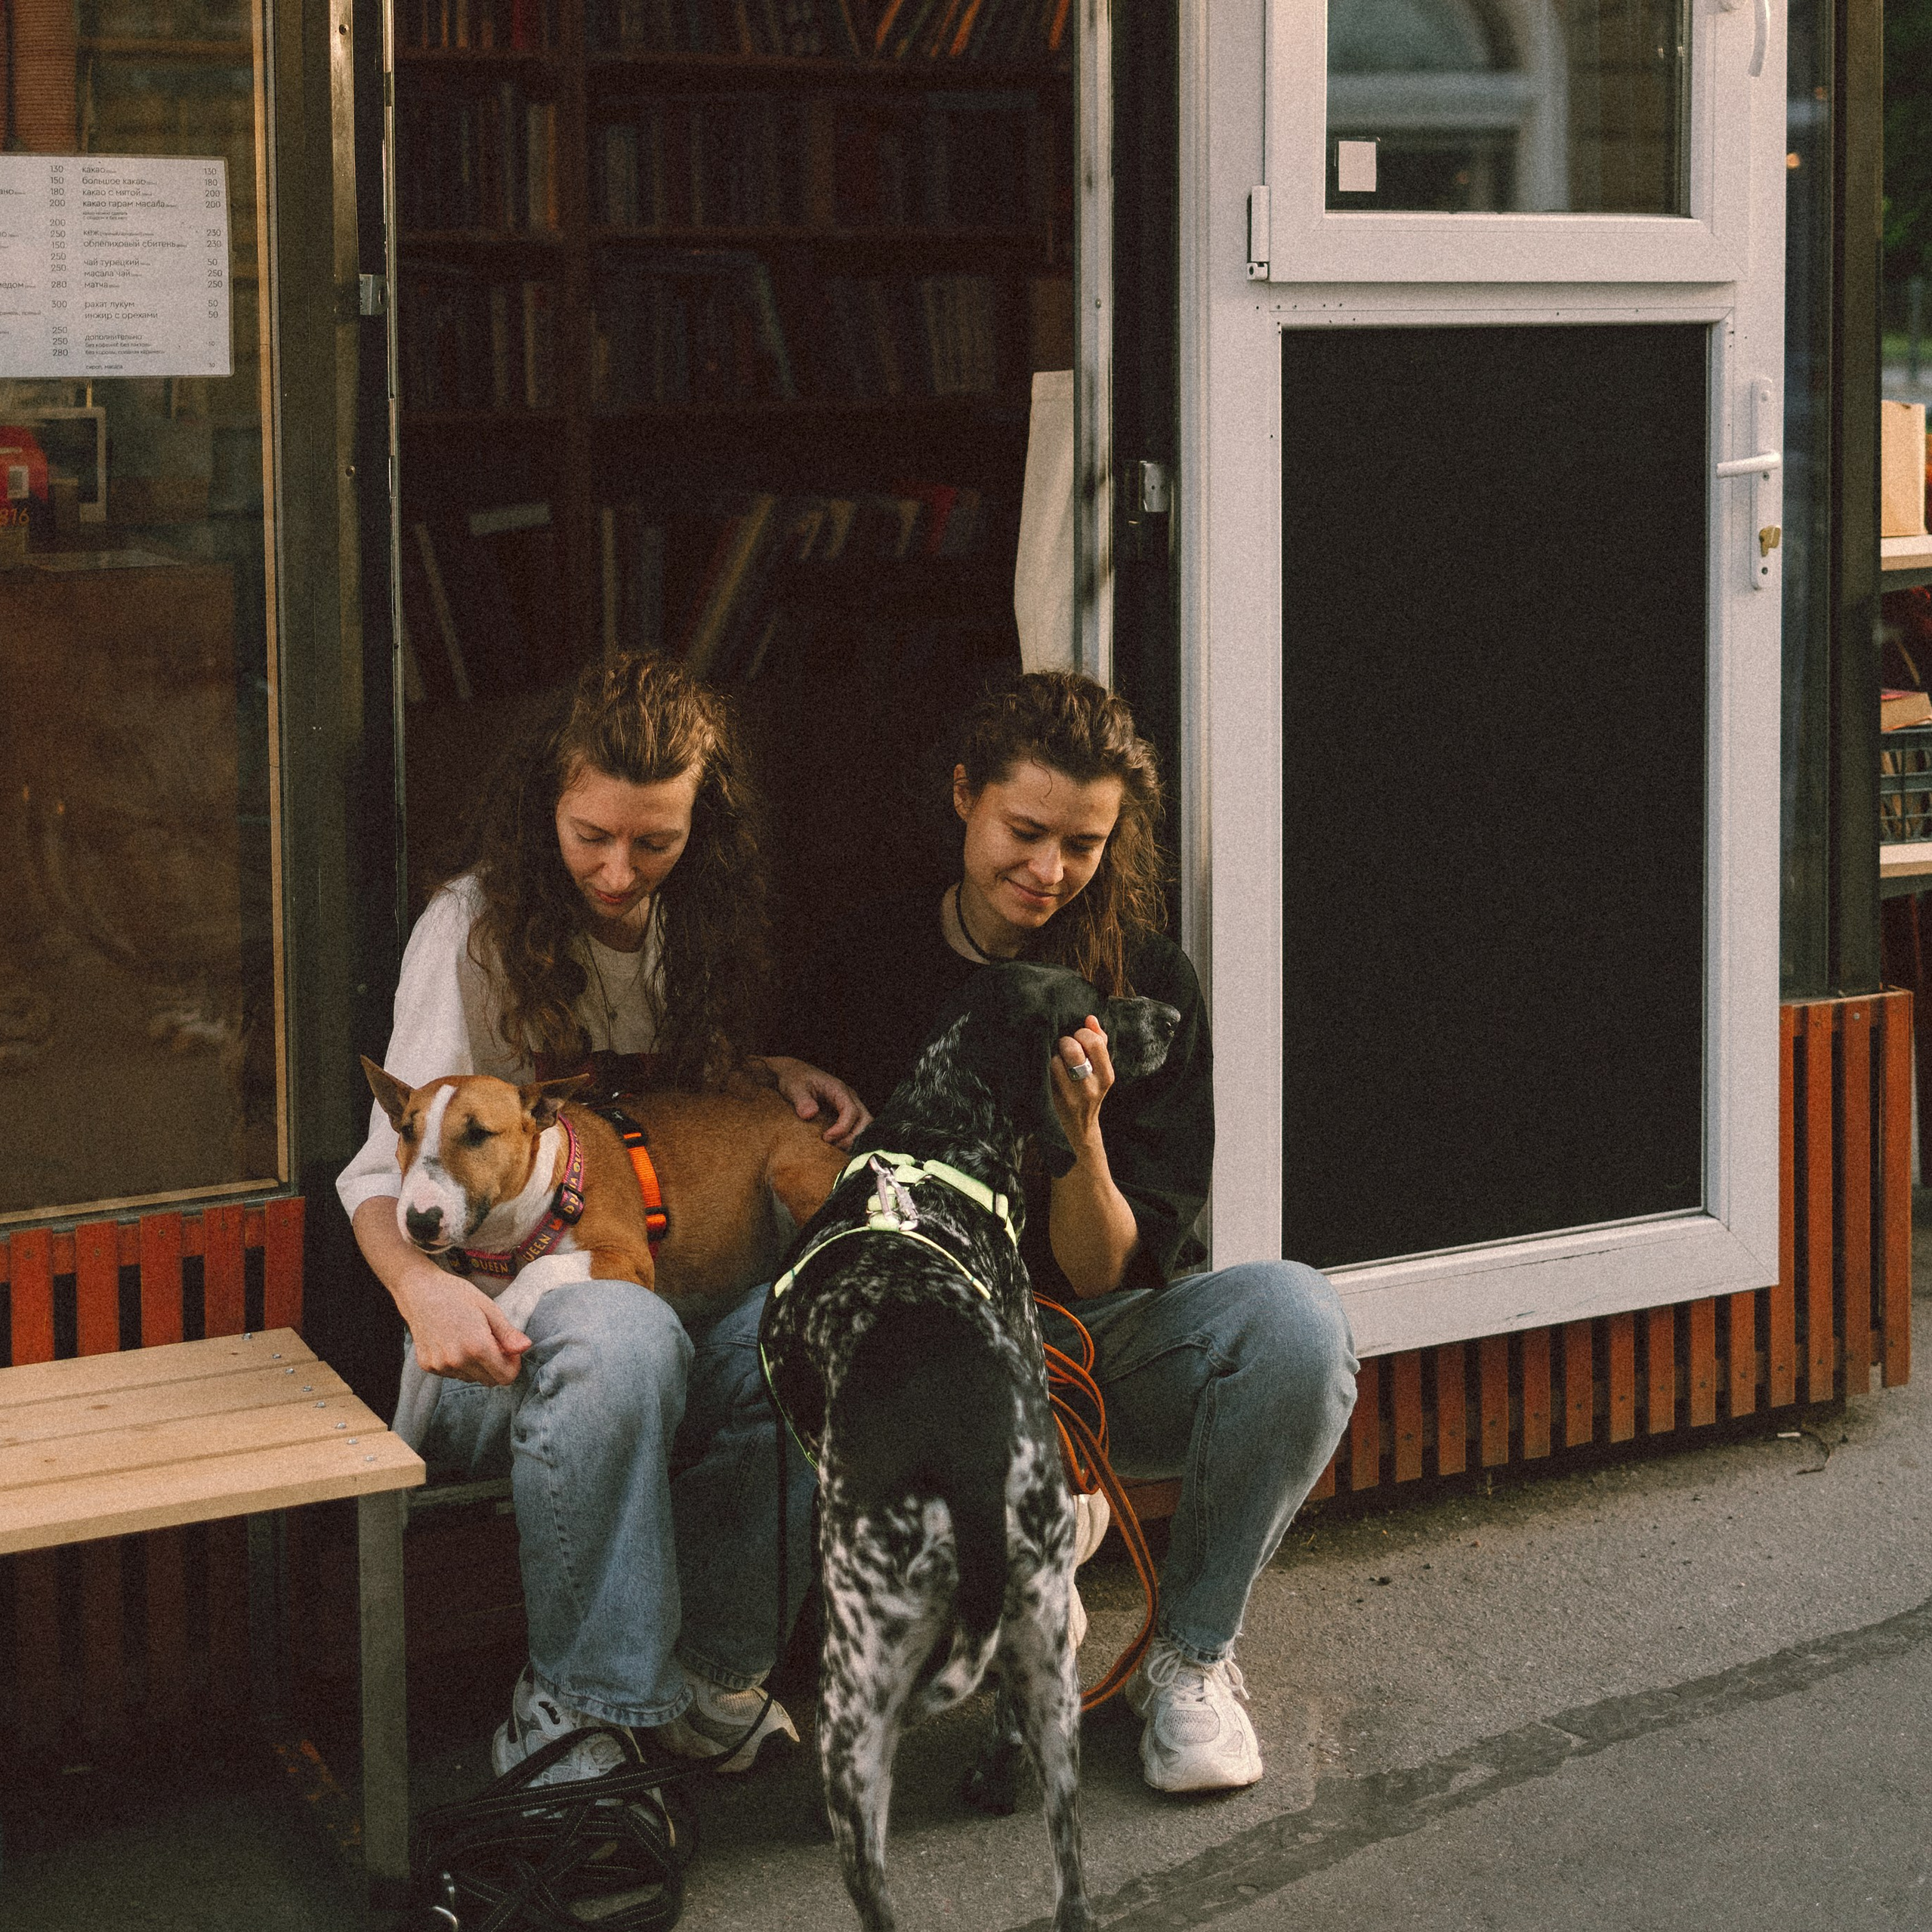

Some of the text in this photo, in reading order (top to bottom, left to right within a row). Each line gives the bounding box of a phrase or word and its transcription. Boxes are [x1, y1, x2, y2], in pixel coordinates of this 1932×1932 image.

[50, 165, 64, 173] 130
[50, 176, 64, 184] 150
[82, 176, 121, 185] большое
[205, 178, 218, 187] 180
[51, 187, 65, 196] 180
[116, 188, 141, 196] мятой
[49, 199, 66, 207] 200
[135, 199, 165, 208] масала
[49, 218, 66, 227] 200
[50, 230, 66, 238] 250
[51, 241, 66, 249] 150
[83, 239, 140, 248] облепиховый
[142, 239, 176, 248] сбитень
[51, 252, 66, 261] 250
[100, 258, 140, 267] турецкий
[51, 264, 66, 272] 250
[116, 269, 131, 277] чай
[208, 269, 223, 277] 250
[51, 280, 67, 289] 280
[208, 280, 223, 289] 250
[51, 300, 67, 308] 300
[85, 301, 107, 309] рахат
[208, 299, 218, 307] 50
[85, 312, 113, 320] инжир
[122, 312, 158, 320] орехами
[208, 310, 219, 319] 50
[52, 337, 69, 345] 250
[52, 348, 69, 356] 280
[523, 1233, 552, 1262] UEEN
[471, 1258, 509, 1273] QUEEN
